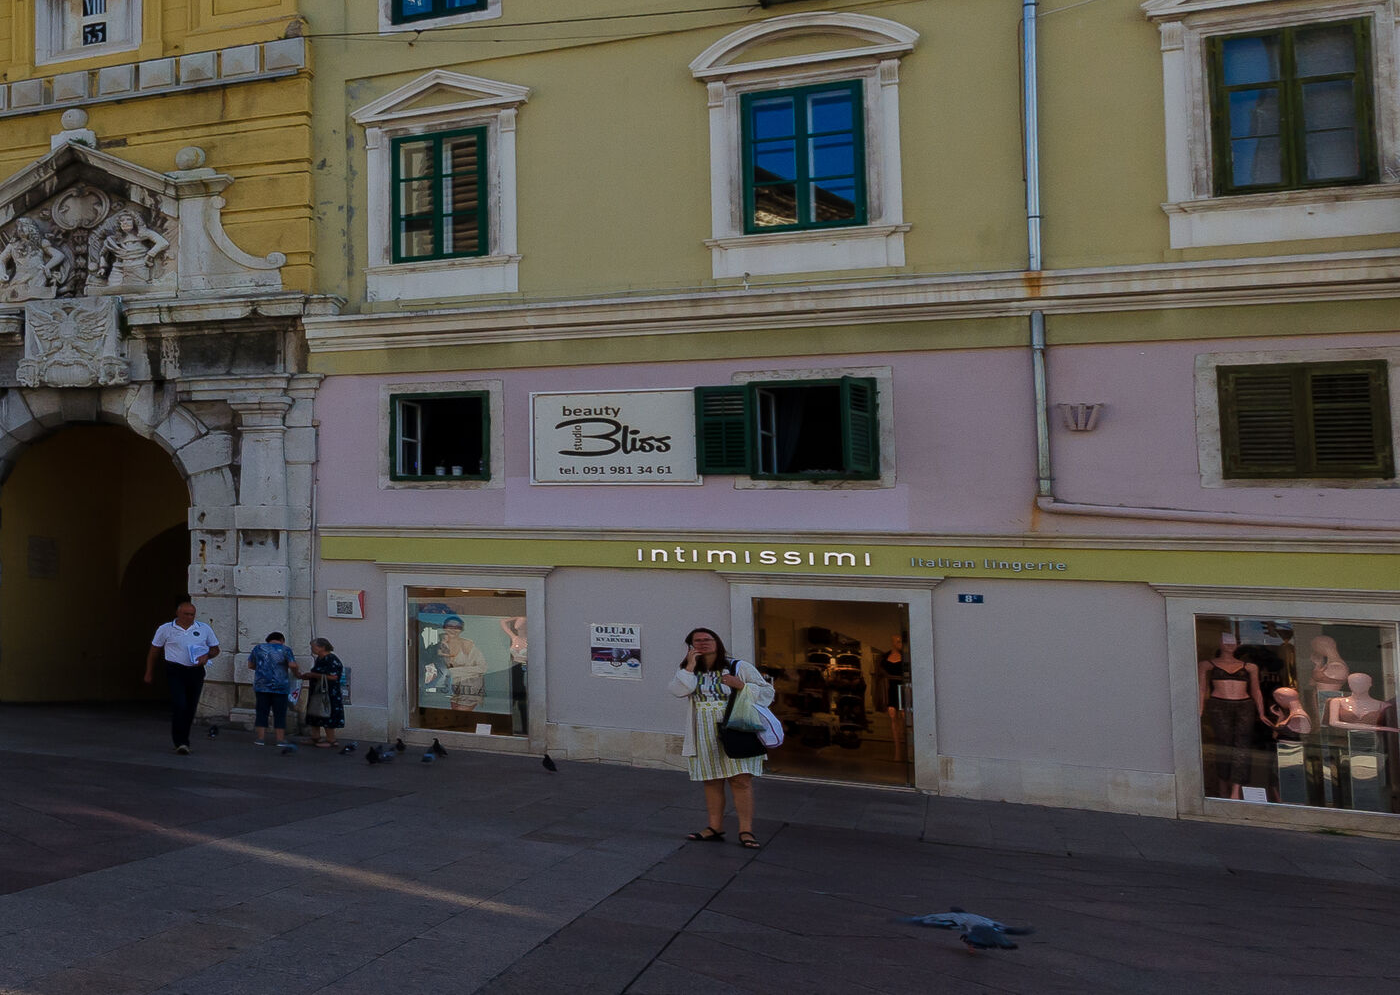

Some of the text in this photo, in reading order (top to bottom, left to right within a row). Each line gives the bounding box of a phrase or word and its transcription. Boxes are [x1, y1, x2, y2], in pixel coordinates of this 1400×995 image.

[562, 406, 621, 418] beauty
[555, 417, 672, 457] Bliss
[572, 425, 582, 451] studio
[559, 466, 673, 475] tel. 091 981 34 61
[637, 546, 871, 567] intimissimi
[910, 557, 1068, 573] Italian lingerie
[595, 625, 635, 635] OLUJA
